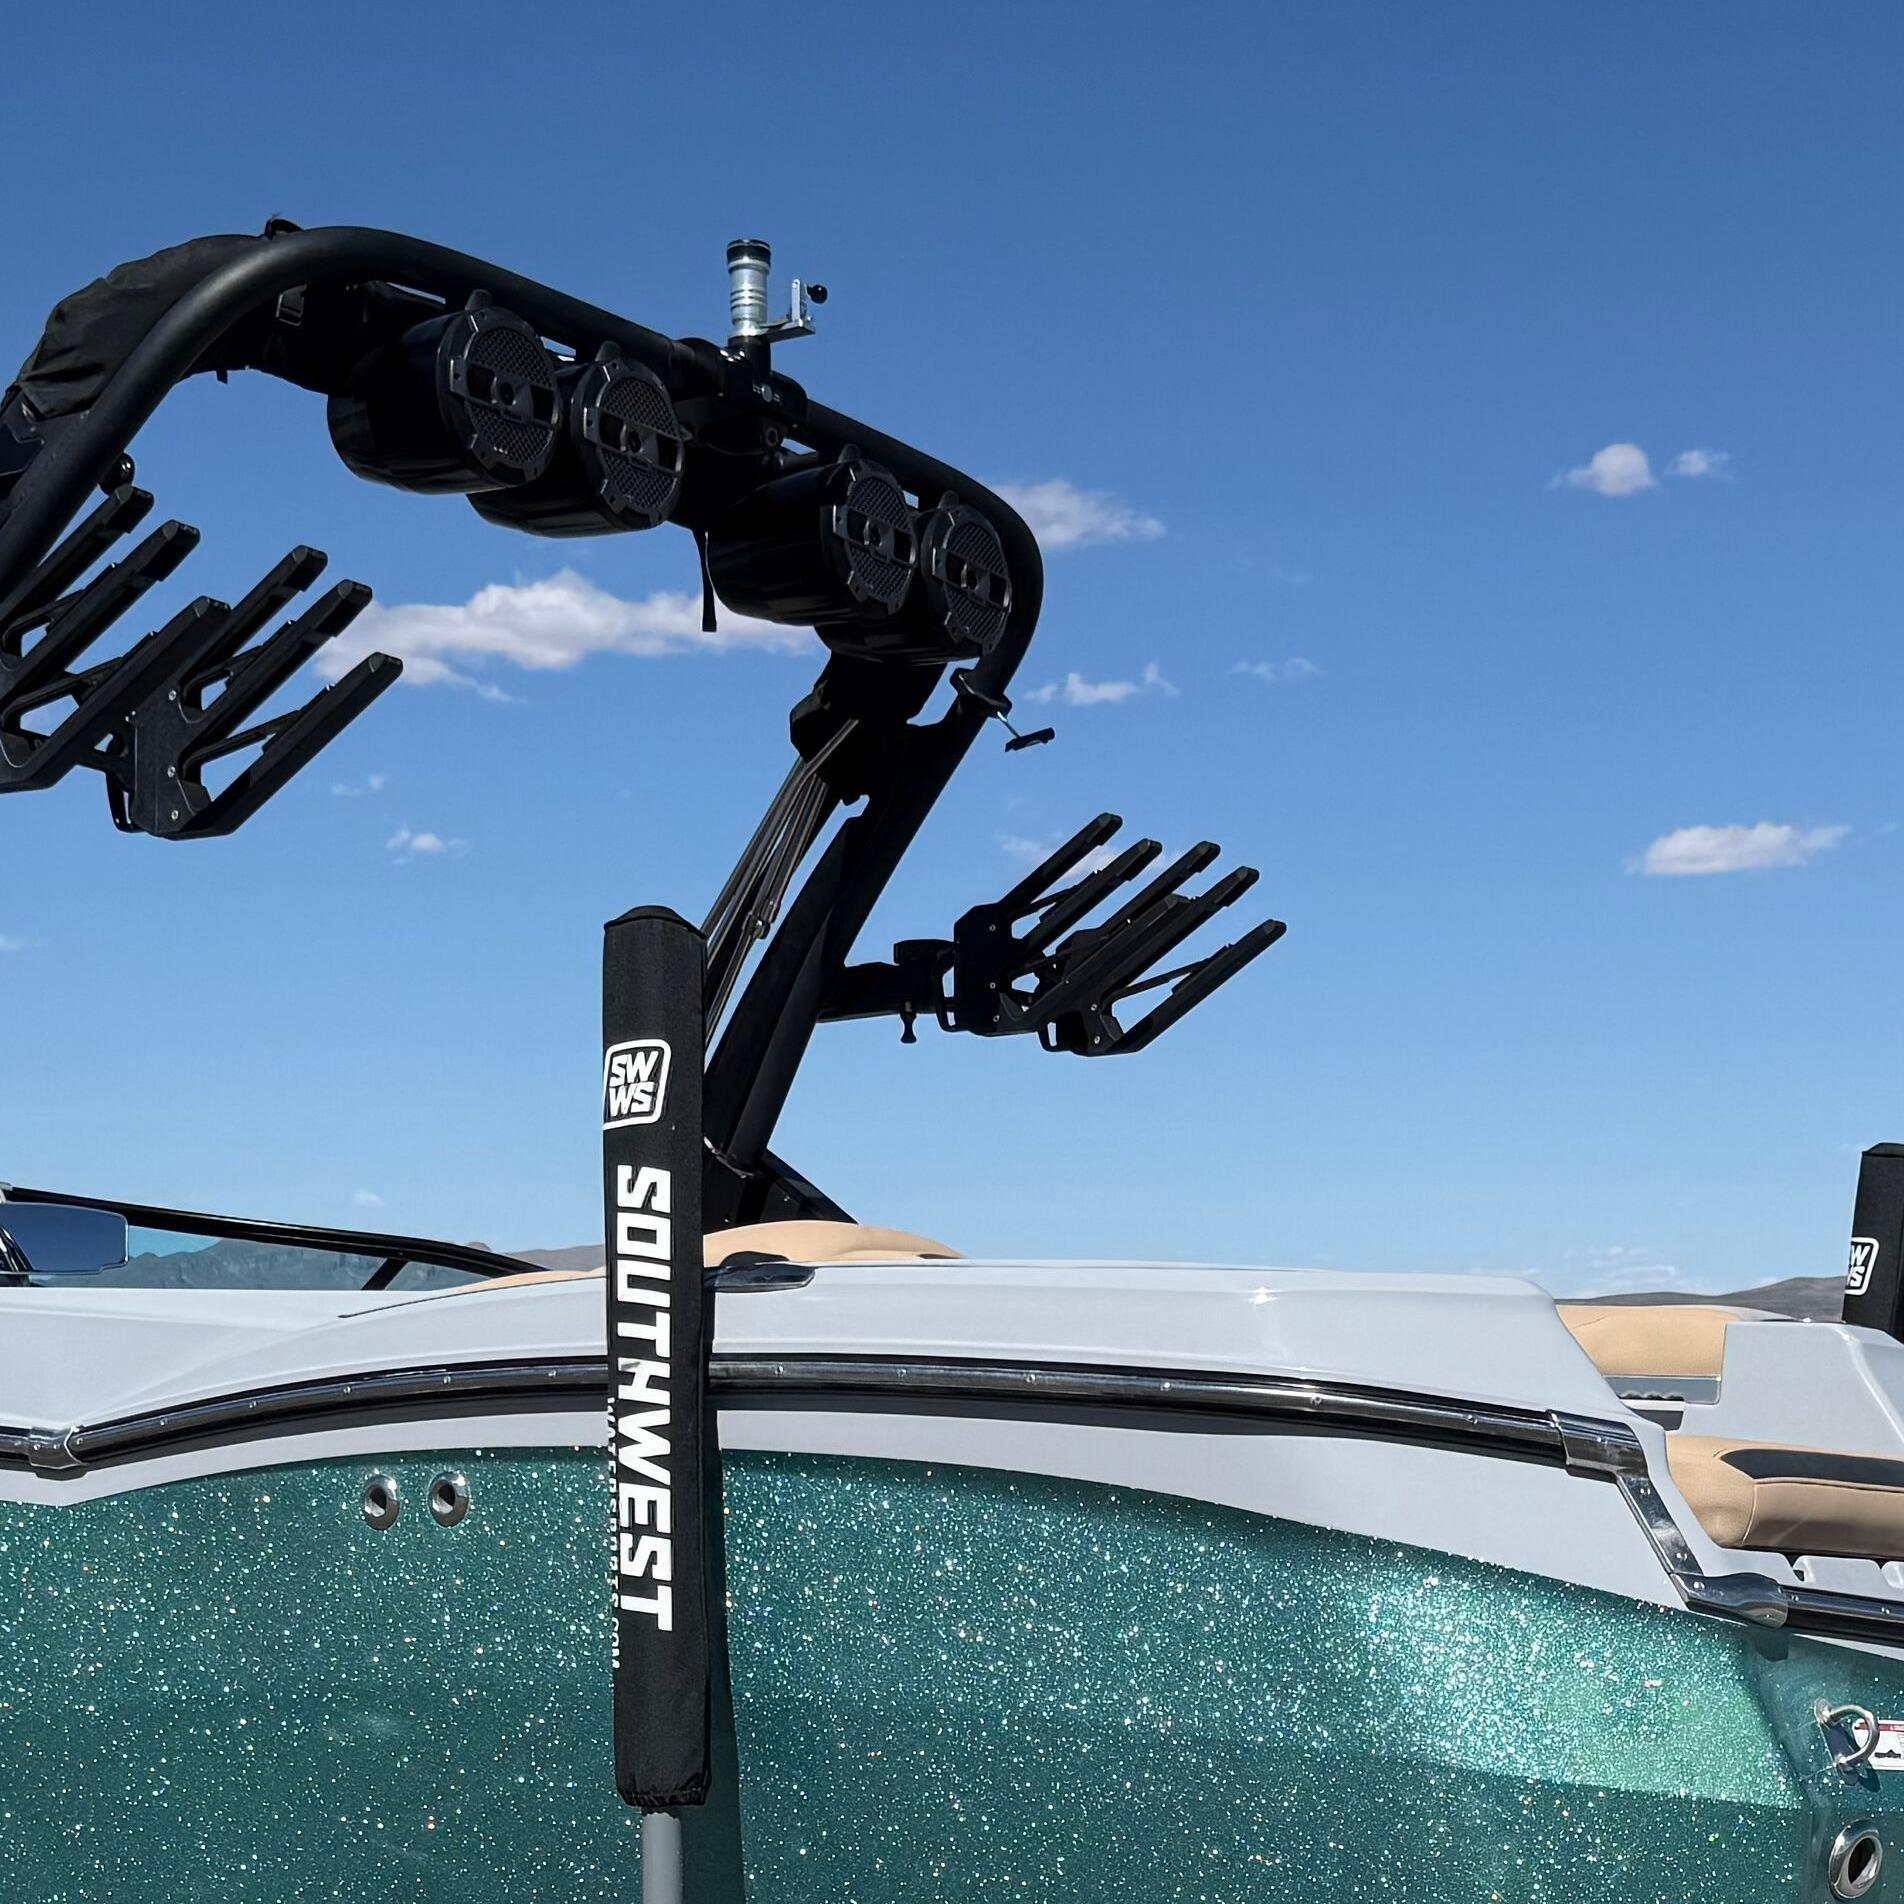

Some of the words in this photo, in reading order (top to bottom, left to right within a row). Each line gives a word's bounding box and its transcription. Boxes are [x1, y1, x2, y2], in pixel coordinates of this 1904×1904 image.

[609, 1050, 659, 1087] SW
[609, 1081, 655, 1117] WS
[617, 1165, 673, 1633] SOUTHWEST
